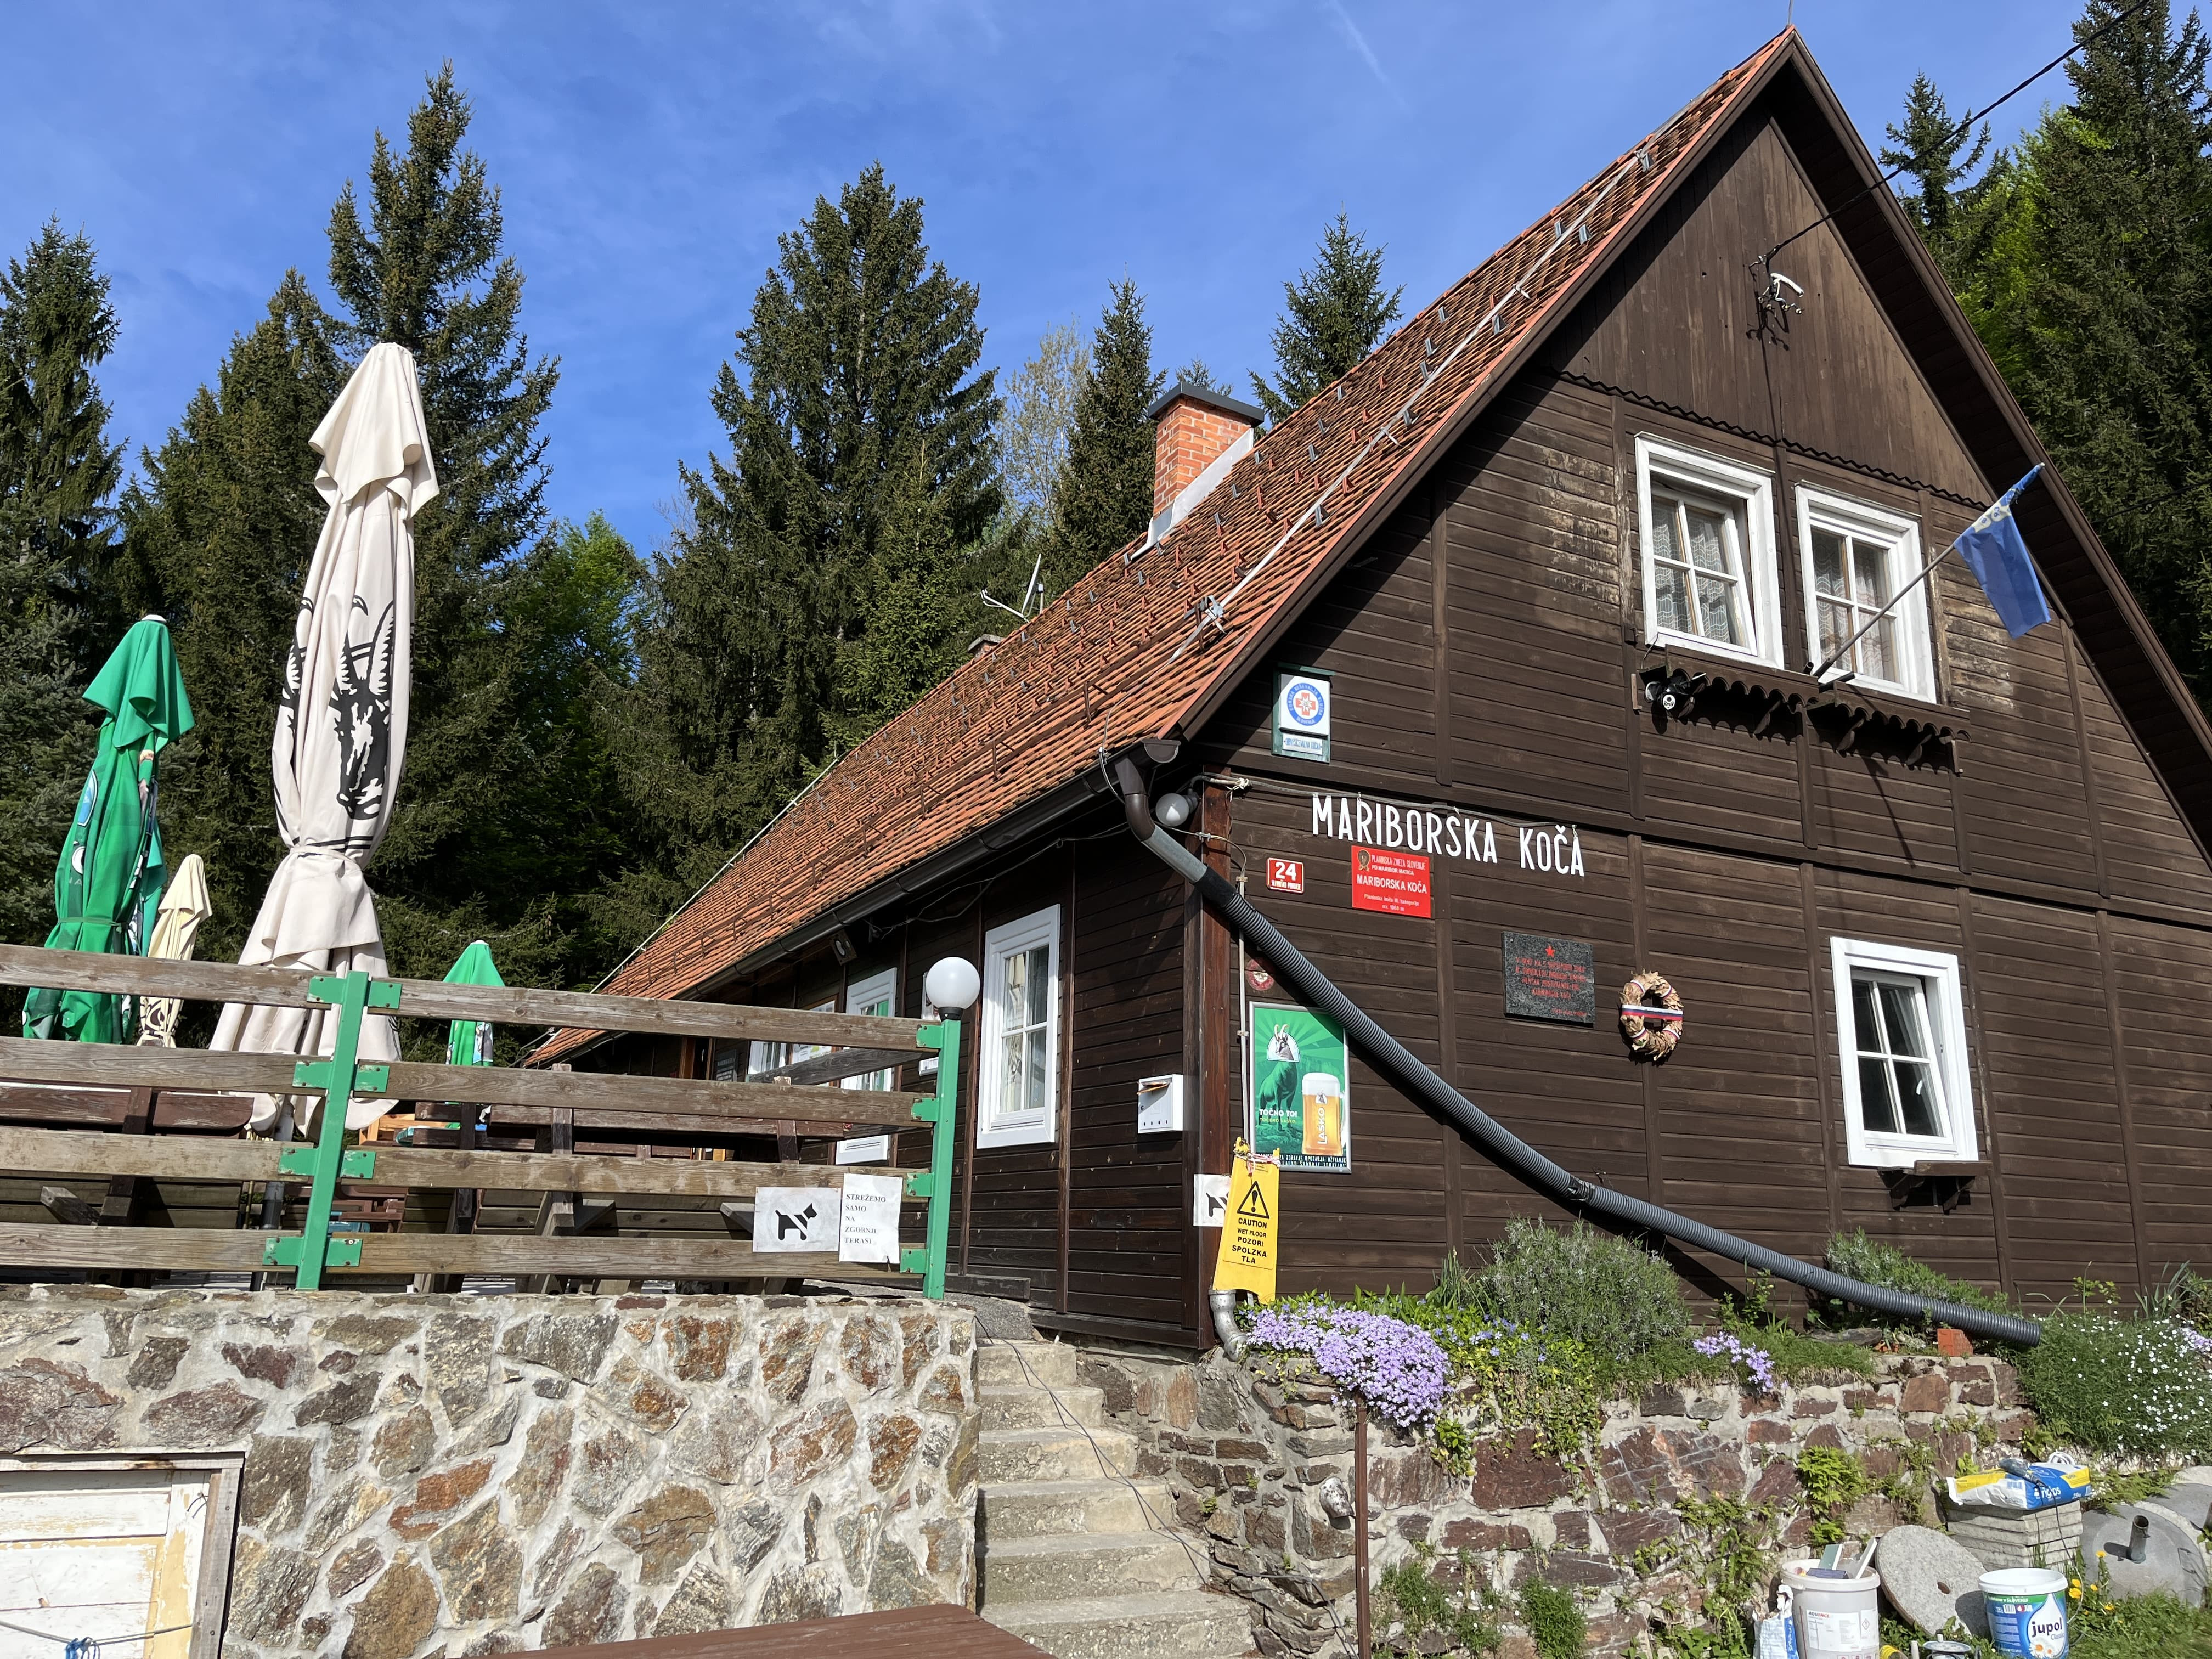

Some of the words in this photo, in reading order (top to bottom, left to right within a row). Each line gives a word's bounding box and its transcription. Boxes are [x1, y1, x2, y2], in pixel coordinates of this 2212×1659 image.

[1312, 793, 1498, 864] MARIBORSKA
[1519, 824, 1585, 877] KOČA
[1372, 855, 1392, 865] PLANINSKA
[1393, 857, 1406, 867] ZVEZA
[1407, 860, 1426, 871] SLOVENIJE
[1378, 865, 1398, 873] MARIBOR
[1275, 861, 1297, 881] 24
[1357, 874, 1406, 891] MARIBORSKA
[1407, 880, 1427, 894] KOČA
[1259, 1108, 1284, 1117] TOČNO
[1317, 1107, 1328, 1145] LAŠKO
[846, 1193, 887, 1203] STREŽEMO
[1238, 1217, 1267, 1229] CAUTION
[1237, 1236, 1264, 1247] POZOR!
[1232, 1245, 1267, 1257] SPOLZKA
[1242, 1255, 1256, 1264] TLA
[2032, 1617, 2062, 1637] jupol
